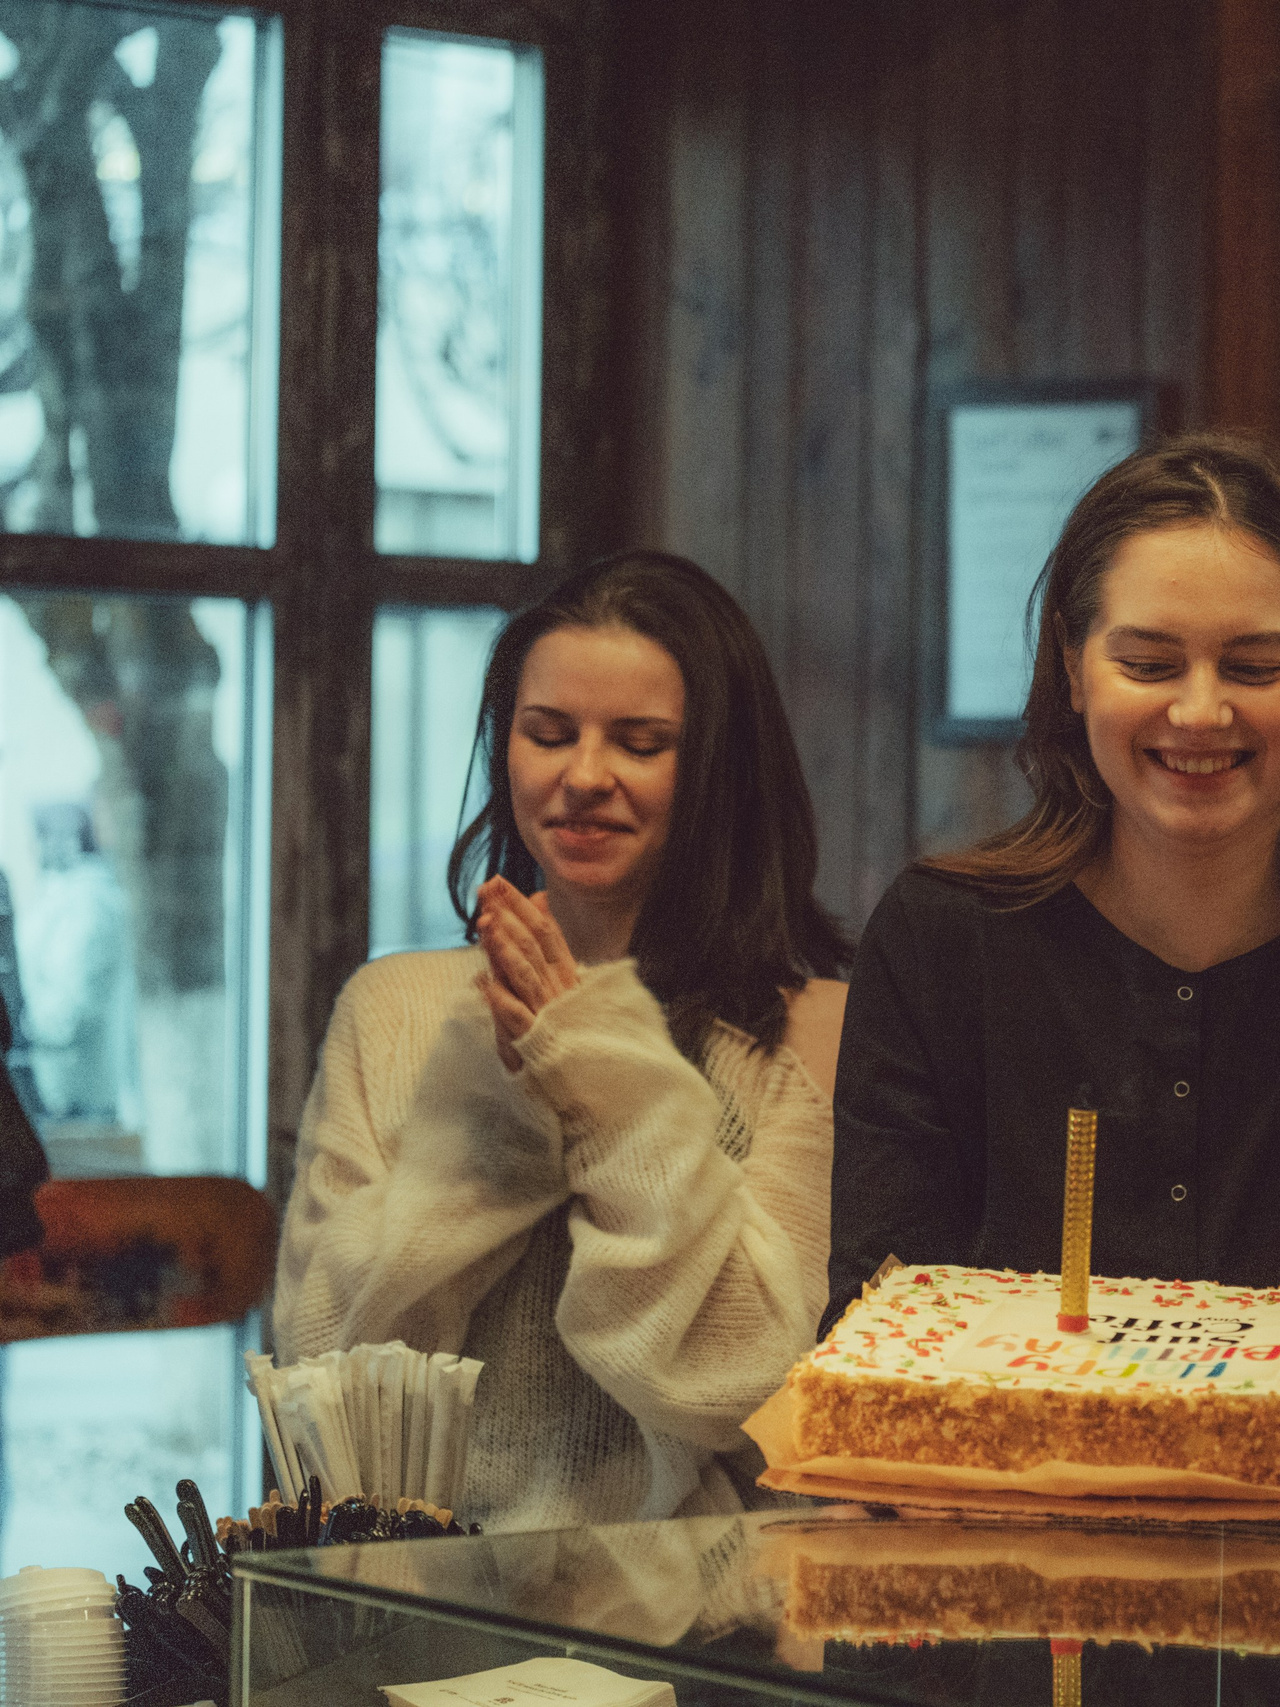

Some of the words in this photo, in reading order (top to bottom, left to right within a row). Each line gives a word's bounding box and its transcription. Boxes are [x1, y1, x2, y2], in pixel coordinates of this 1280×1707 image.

[1088, 1314, 1255, 1334] Coffe
[1096, 1331, 1247, 1347] Surf
[1007, 1354, 1228, 1379] HAPPY
